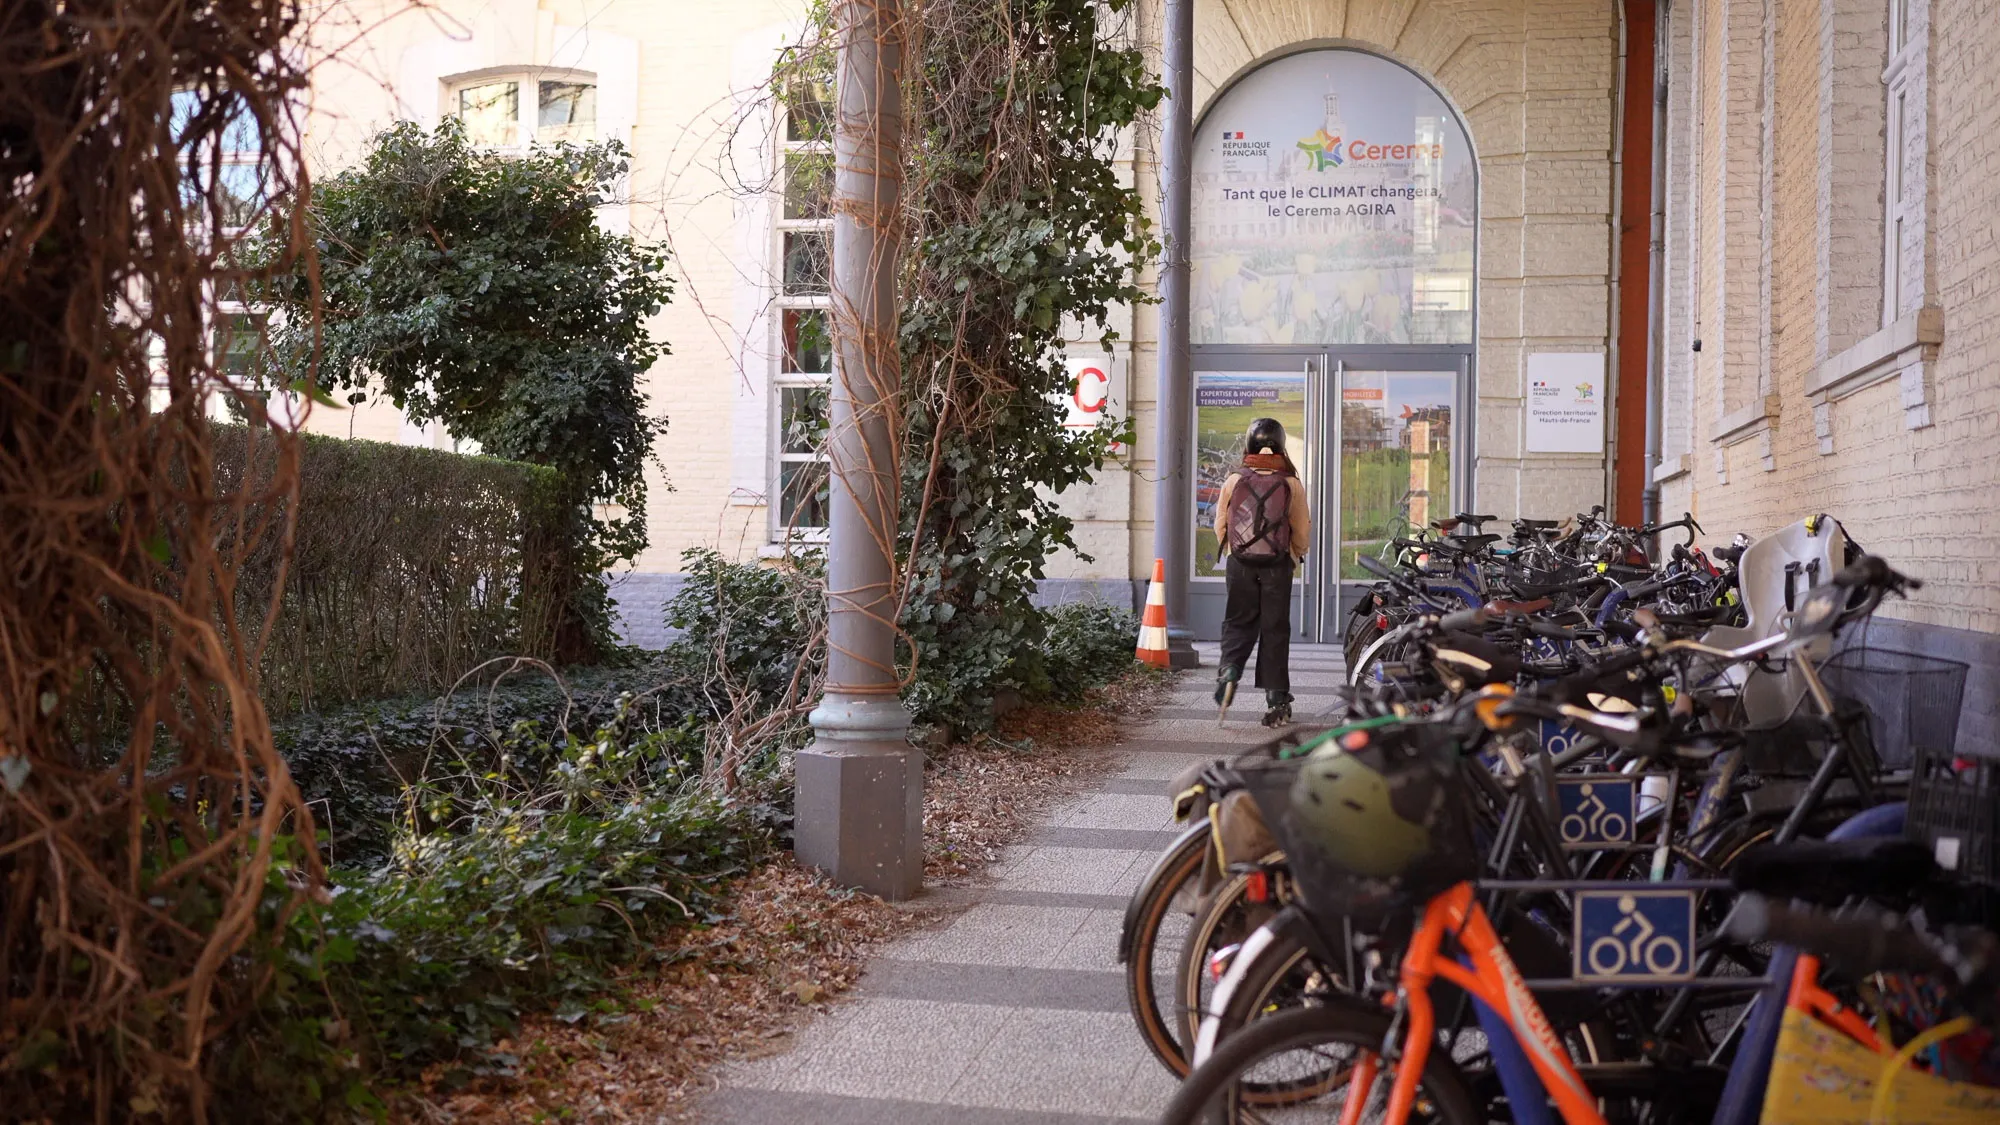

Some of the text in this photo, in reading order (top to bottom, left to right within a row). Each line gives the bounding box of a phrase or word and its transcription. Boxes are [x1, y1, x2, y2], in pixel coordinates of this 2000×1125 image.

[1223, 141, 1271, 150] RÉPUBLIQUE
[1348, 140, 1444, 161] Cerema
[1223, 185, 1442, 203] Tant que le CLIMAT changera,
[1268, 203, 1396, 217] le Cerema AGIRA
[1073, 367, 1107, 413] C
